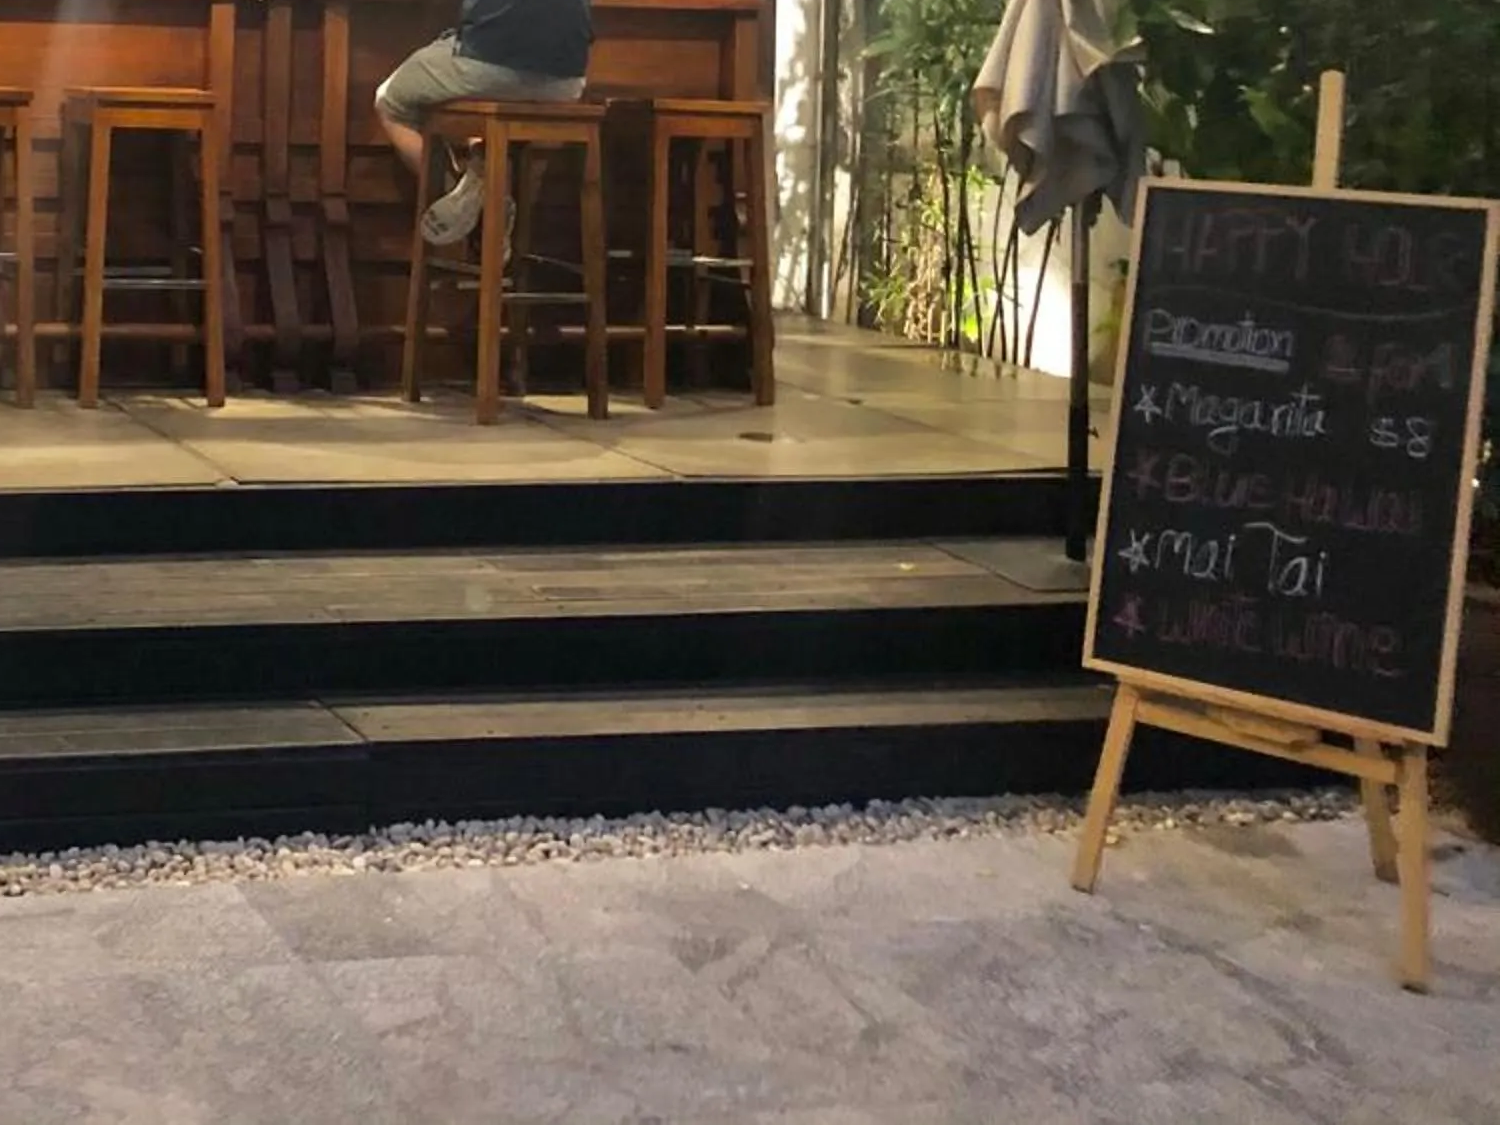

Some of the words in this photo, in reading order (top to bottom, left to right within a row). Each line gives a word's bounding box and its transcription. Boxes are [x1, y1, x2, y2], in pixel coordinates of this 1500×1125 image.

[1143, 308, 1293, 357] Promotion
[1164, 381, 1326, 455] Magarita
[1155, 527, 1236, 580] Mai
[1242, 521, 1327, 598] Tai
